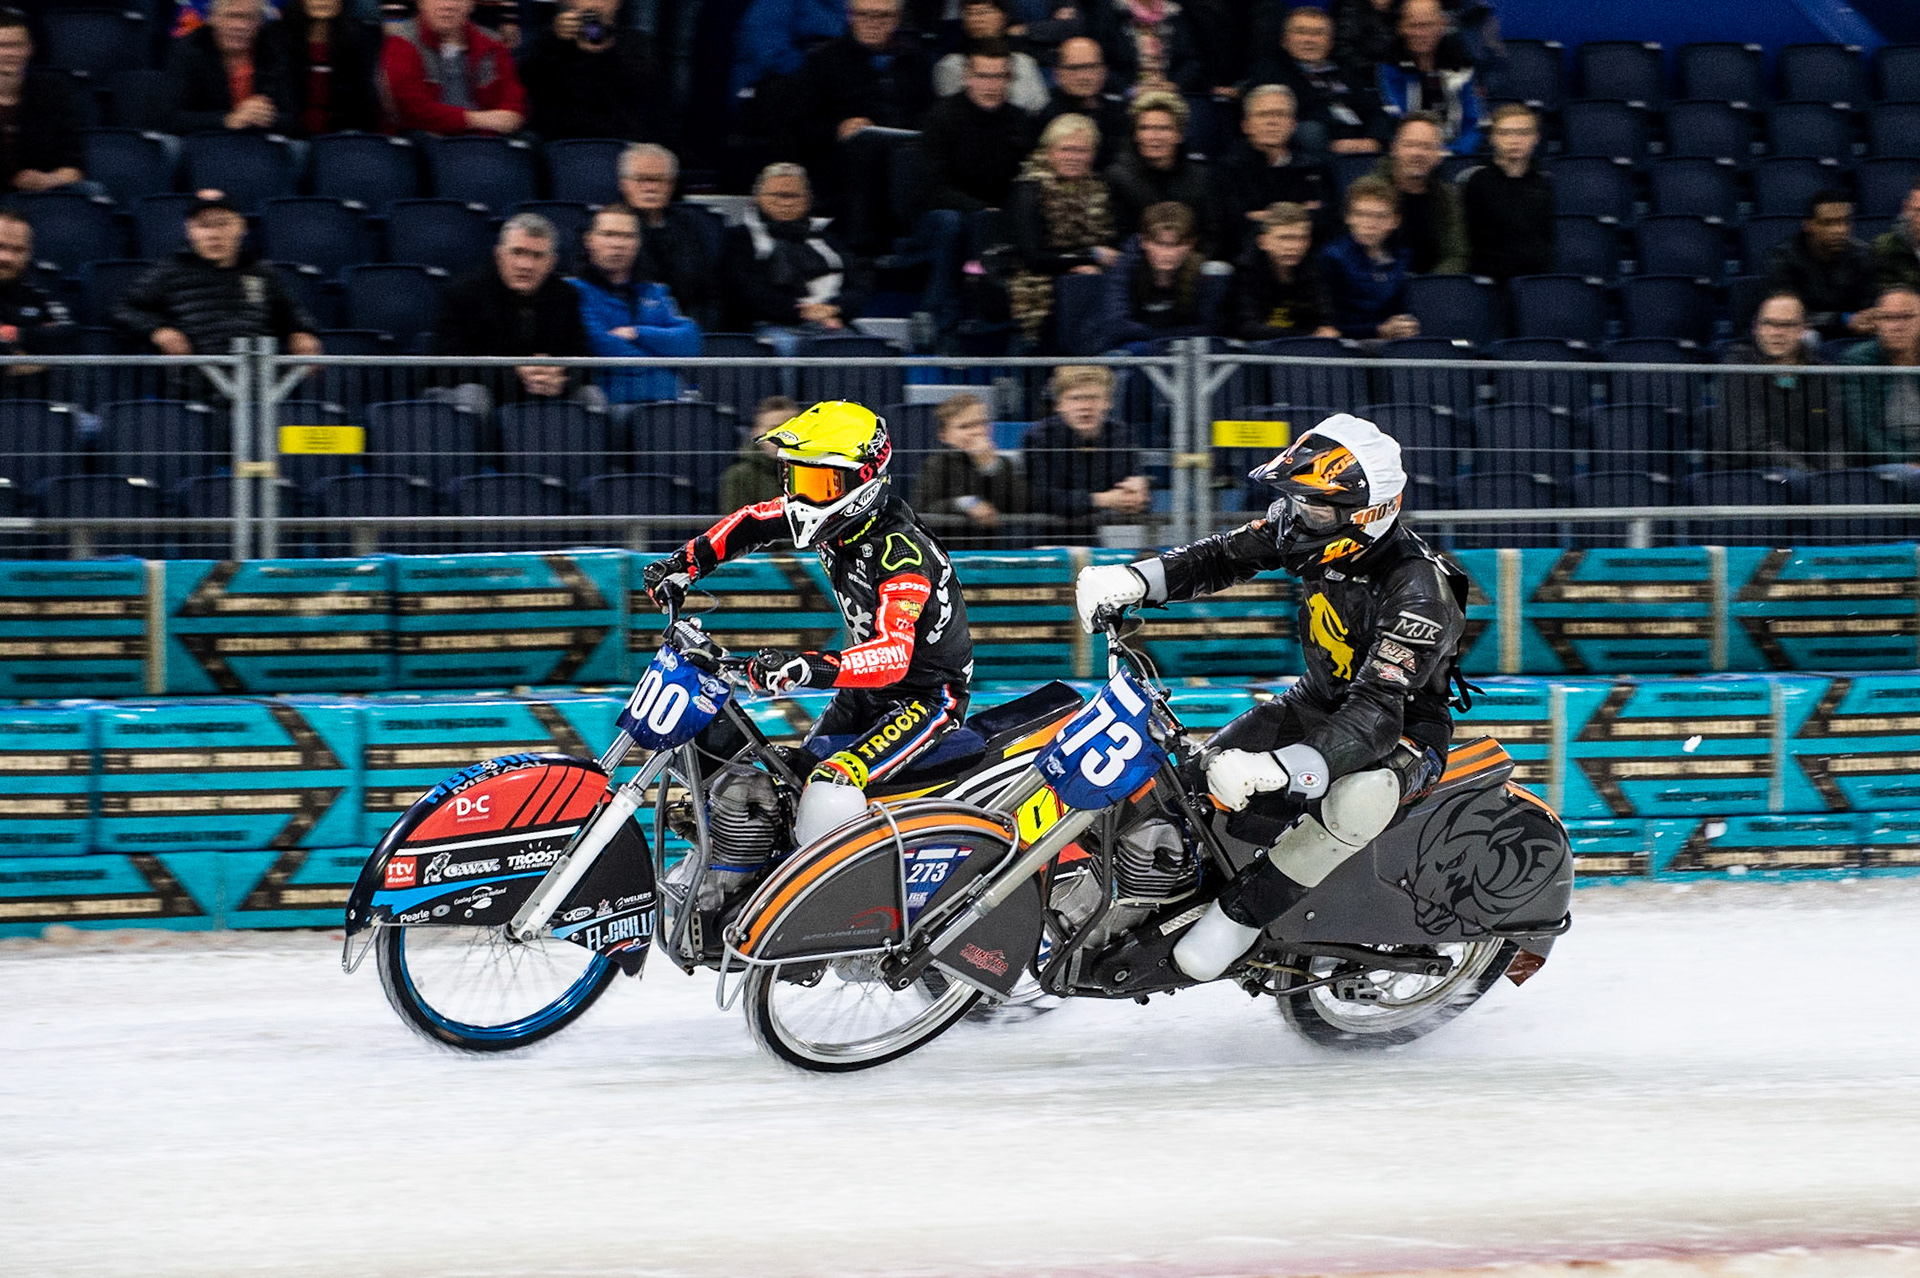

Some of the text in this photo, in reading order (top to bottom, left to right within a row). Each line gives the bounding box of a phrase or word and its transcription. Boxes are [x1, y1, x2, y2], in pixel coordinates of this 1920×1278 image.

[1392, 618, 1441, 640] MJK
[853, 662, 908, 676] METAAL
[858, 700, 928, 760] TROOST
[451, 760, 549, 795] METAAL
[387, 860, 415, 877] rtv
[506, 850, 562, 868] TROOST
[906, 862, 949, 884] 273
[400, 910, 430, 923] Pearle
